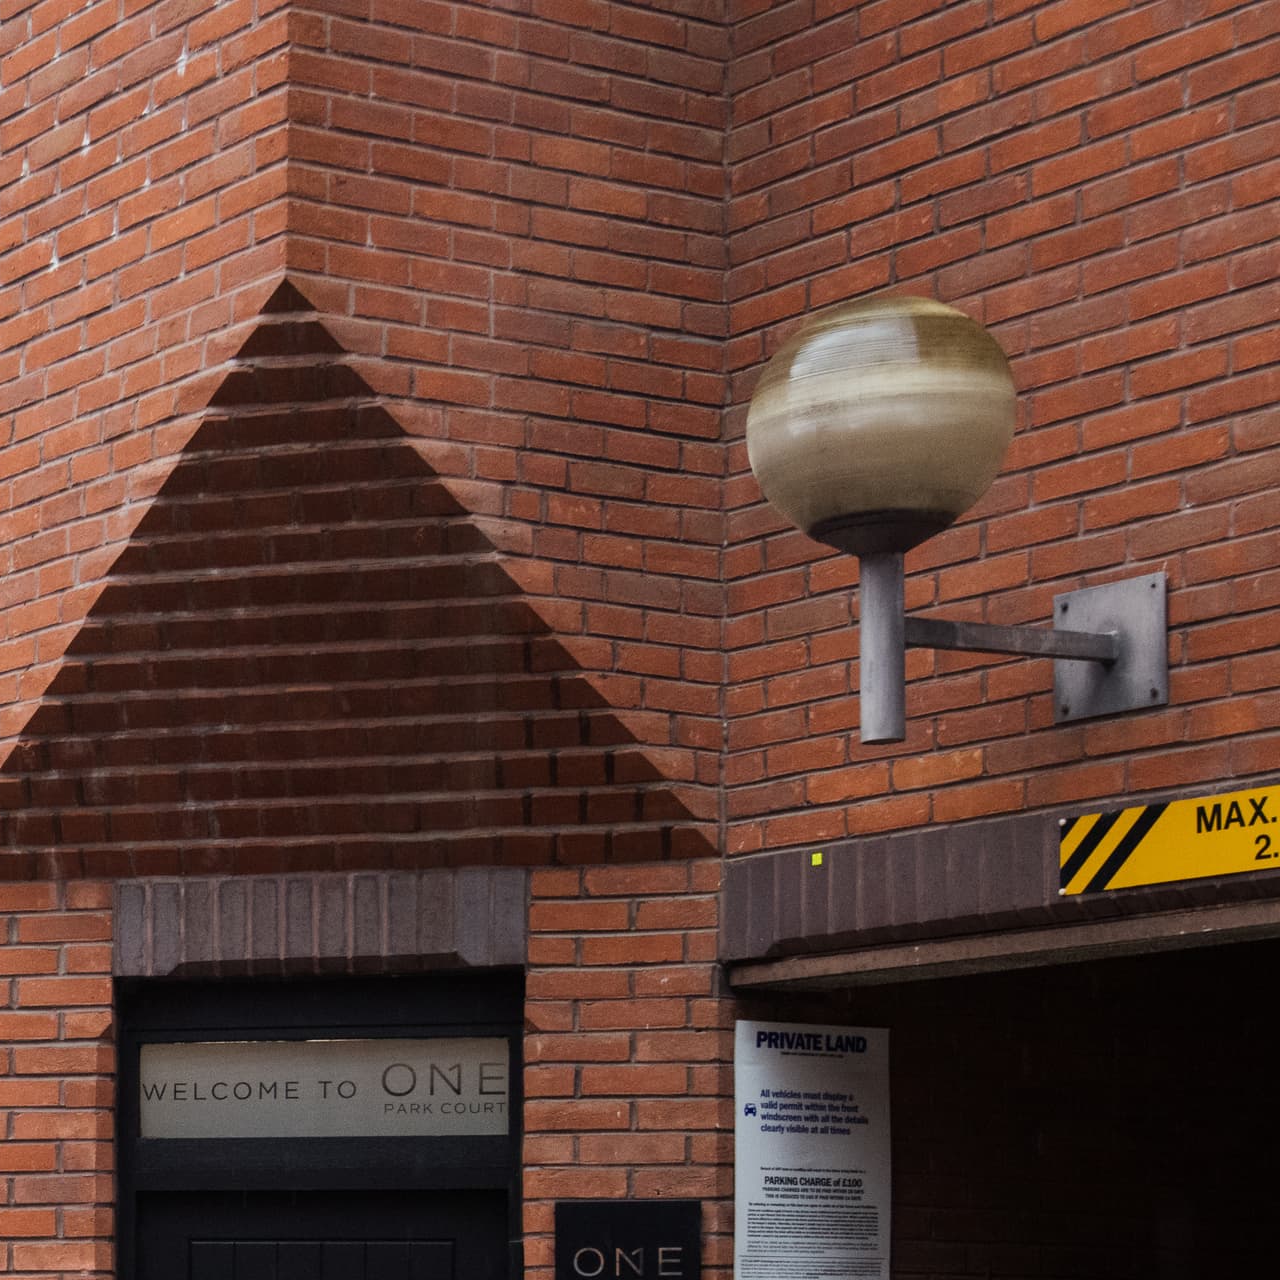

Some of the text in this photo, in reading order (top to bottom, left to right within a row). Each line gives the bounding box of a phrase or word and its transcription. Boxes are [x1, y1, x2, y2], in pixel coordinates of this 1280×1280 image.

[1196, 796, 1278, 833] MAX.
[756, 1031, 867, 1053] PRIVATE LAND
[381, 1061, 507, 1097] ONE
[142, 1080, 358, 1102] WELCOME TO
[760, 1089, 769, 1097] All
[772, 1090, 801, 1098] vehicles
[823, 1092, 848, 1102] display
[383, 1101, 507, 1115] PARK COURT
[760, 1101, 778, 1109] valid
[779, 1102, 803, 1111] permit
[804, 1103, 827, 1111] within
[760, 1113, 802, 1121] windscreen
[803, 1114, 820, 1122] with
[831, 1115, 843, 1123] the
[845, 1116, 869, 1124] details
[760, 1124, 784, 1134] clearly
[786, 1125, 809, 1133] visible
[820, 1126, 829, 1134] all
[830, 1127, 850, 1135] times
[764, 1176, 863, 1187] PARKING CHARGE of £100
[572, 1246, 683, 1277] ONE
